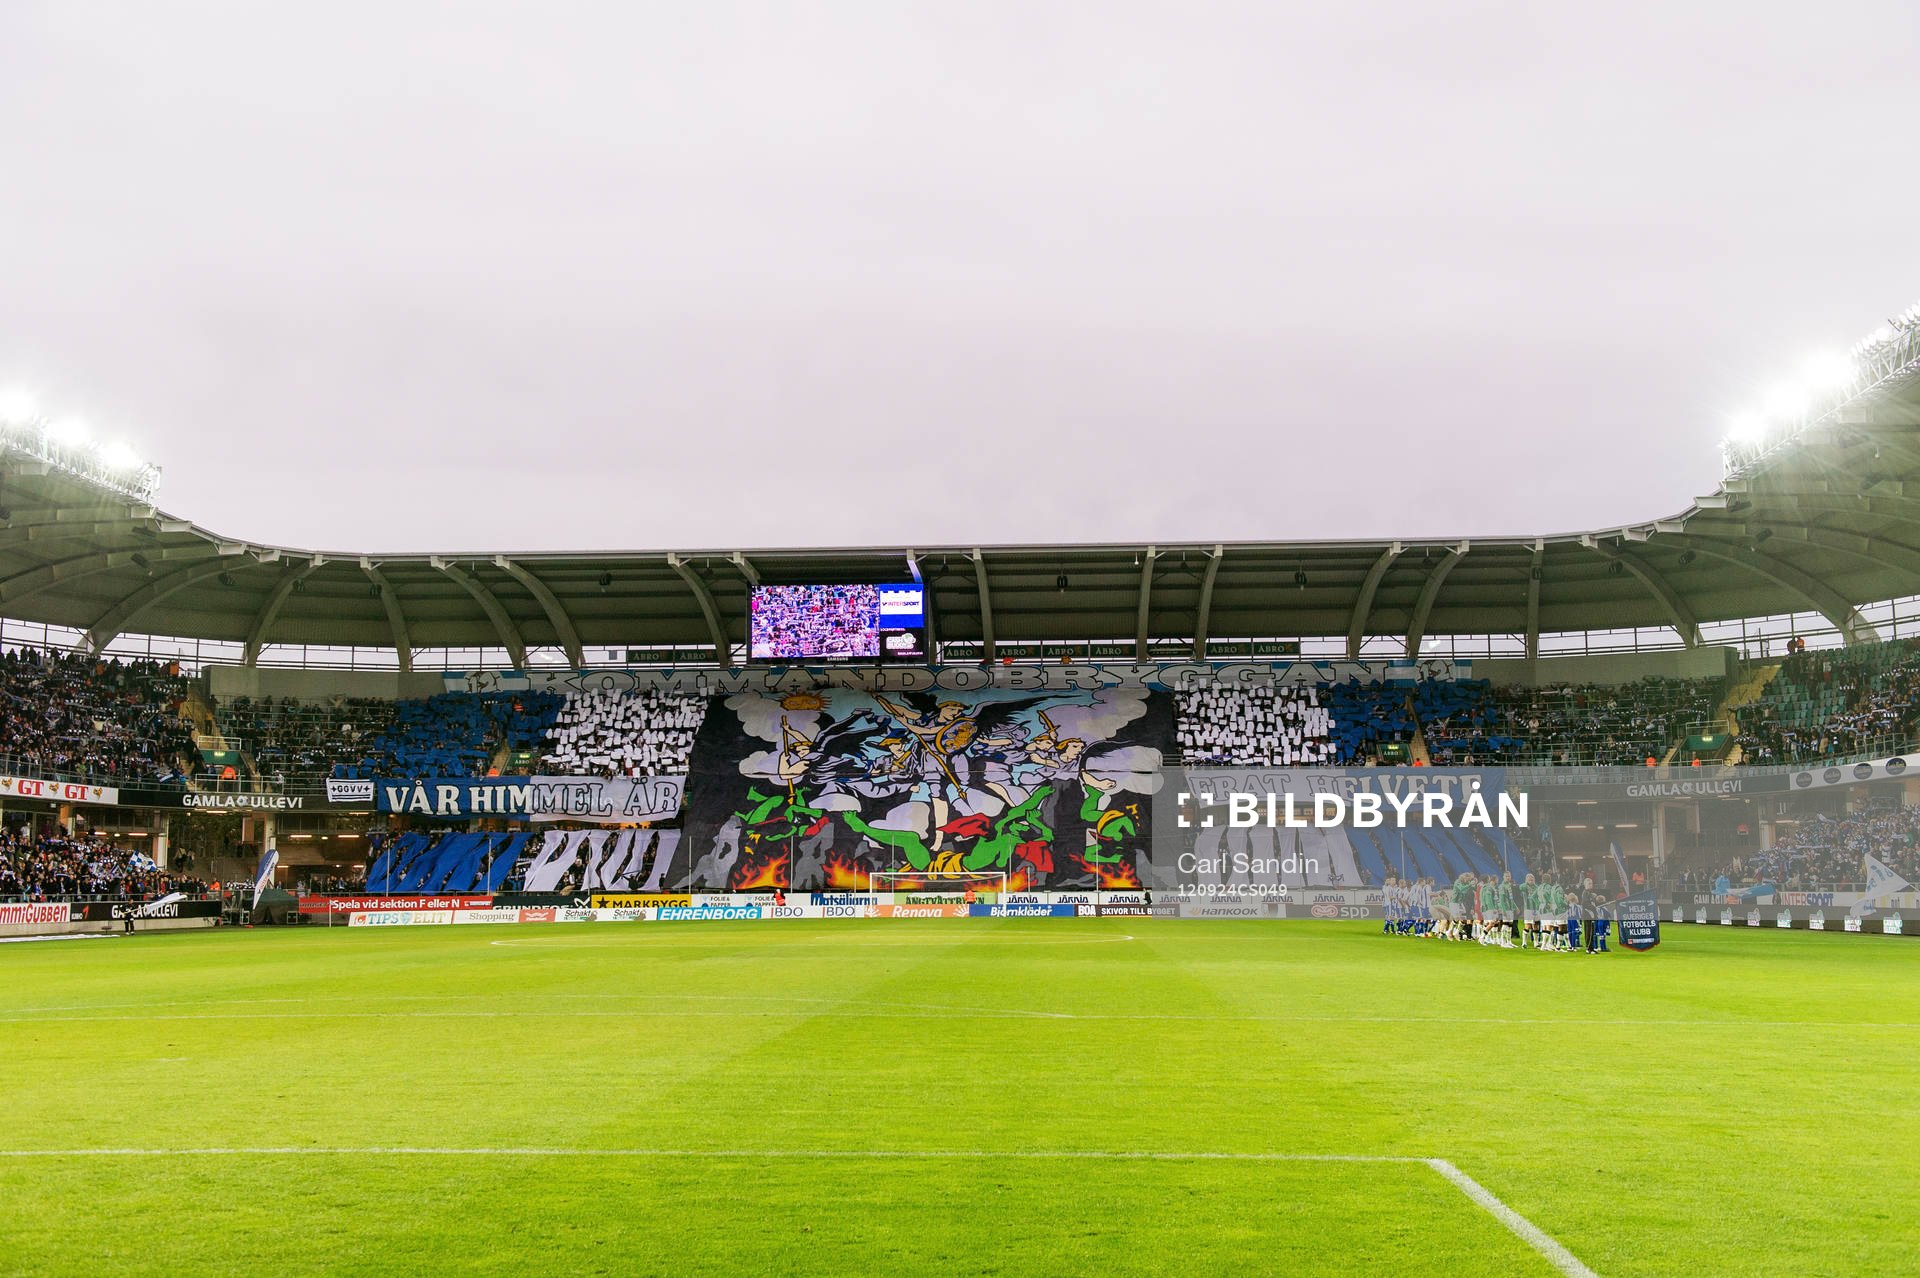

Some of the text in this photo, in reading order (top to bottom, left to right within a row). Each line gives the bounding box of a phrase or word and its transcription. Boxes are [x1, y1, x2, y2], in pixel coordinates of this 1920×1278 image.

[525, 662, 1389, 695] KOMMANDOBRYGGAN
[18, 779, 44, 796] GT
[64, 784, 88, 800] GT
[337, 784, 363, 793] GGVV
[1626, 780, 1742, 797] GAMLA ULLEVI
[182, 794, 304, 808] GAMLA ULLEVI
[385, 776, 678, 817] VÅR HIMMEL ÄR
[333, 900, 360, 910] Spela
[361, 900, 378, 909] vid
[379, 899, 418, 909] sektion
[419, 900, 425, 908] F
[427, 899, 449, 908] eller
[451, 899, 460, 908] N
[1078, 905, 1097, 916] BOA
[111, 904, 143, 919] GALA
[469, 912, 515, 922] Shopping
[659, 908, 758, 920] EHRENBORG
[774, 907, 804, 917] BDO
[826, 907, 855, 917] BDO
[892, 906, 943, 918] Renova
[990, 905, 1053, 918] Björnkläder
[1101, 907, 1176, 915] SKIVOR TILL BYGGET
[367, 911, 446, 925] TIPS ELIT
[1622, 920, 1657, 928] FOTBOLLS
